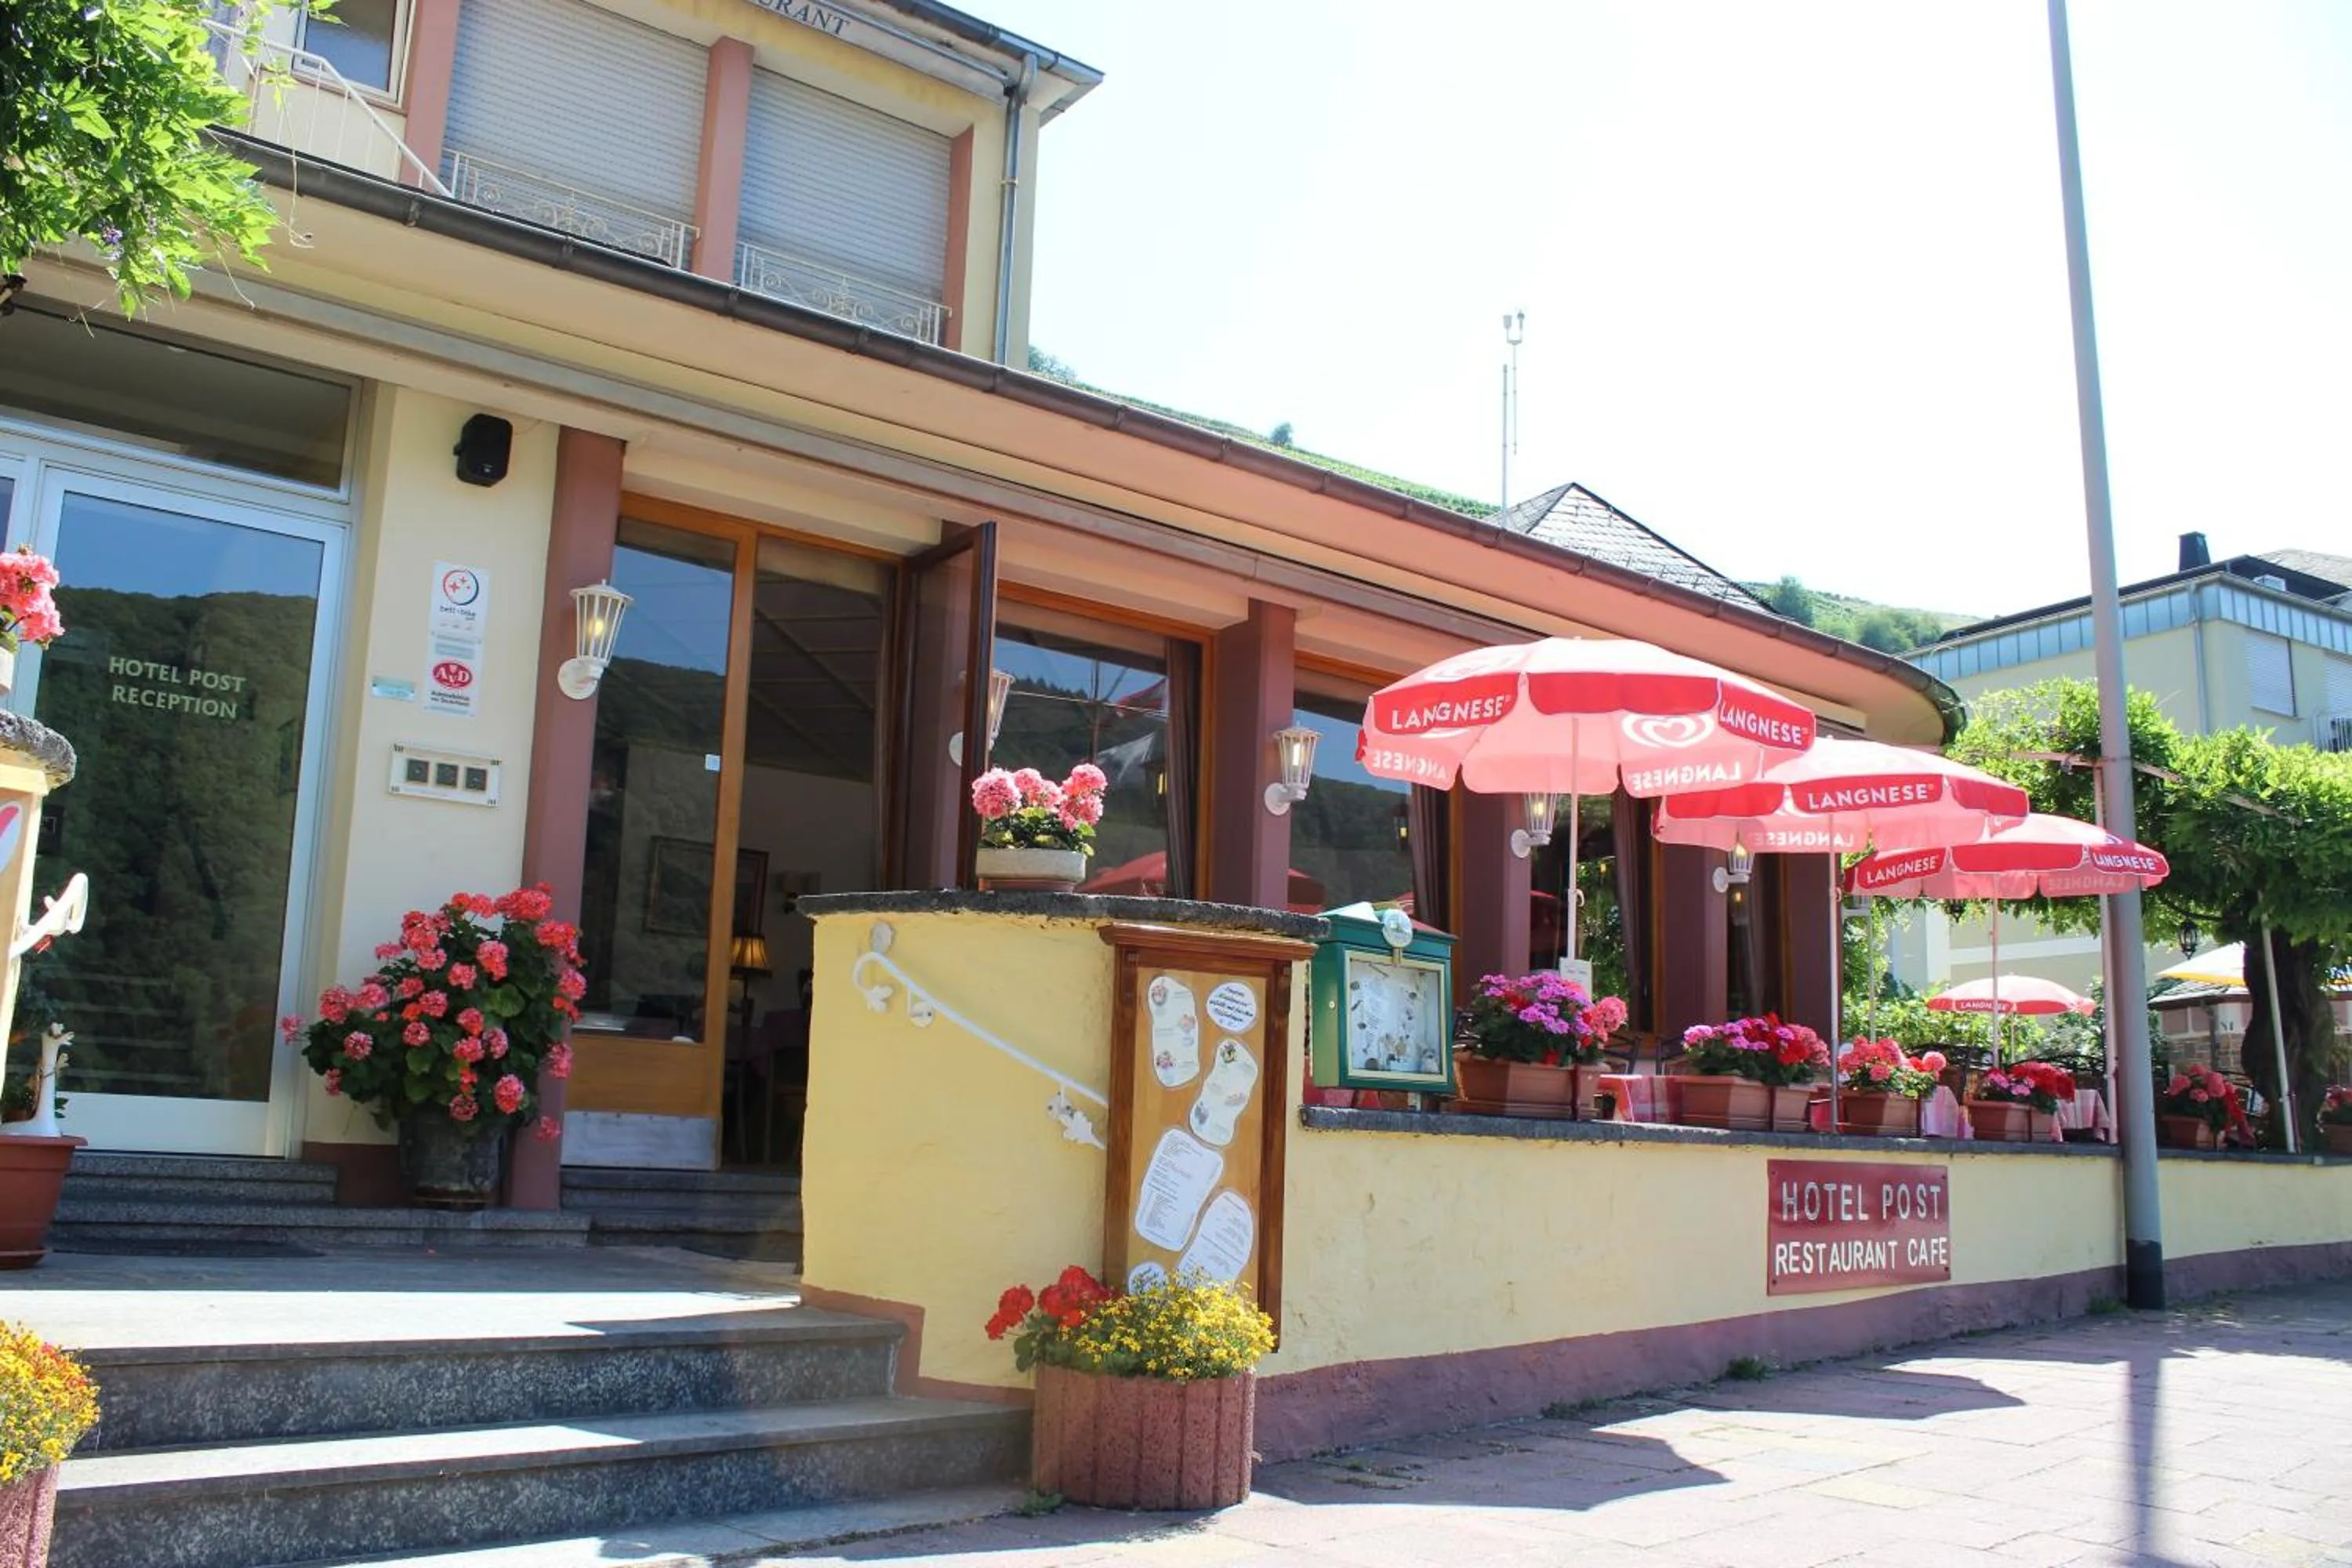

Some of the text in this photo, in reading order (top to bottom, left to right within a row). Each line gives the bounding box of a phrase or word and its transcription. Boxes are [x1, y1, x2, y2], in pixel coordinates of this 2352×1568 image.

[108, 655, 247, 693] HOTEL POST
[112, 684, 238, 719] RECEPTION
[1392, 695, 1504, 729] LANGNESE
[1719, 701, 1803, 745] LANGNESE
[1807, 784, 1929, 811] LANGNESE
[1866, 856, 1937, 884] LANGNESE
[1781, 1181, 1940, 1221] HOTEL POST
[1775, 1236, 1947, 1276] RESTAURANT CAFE
